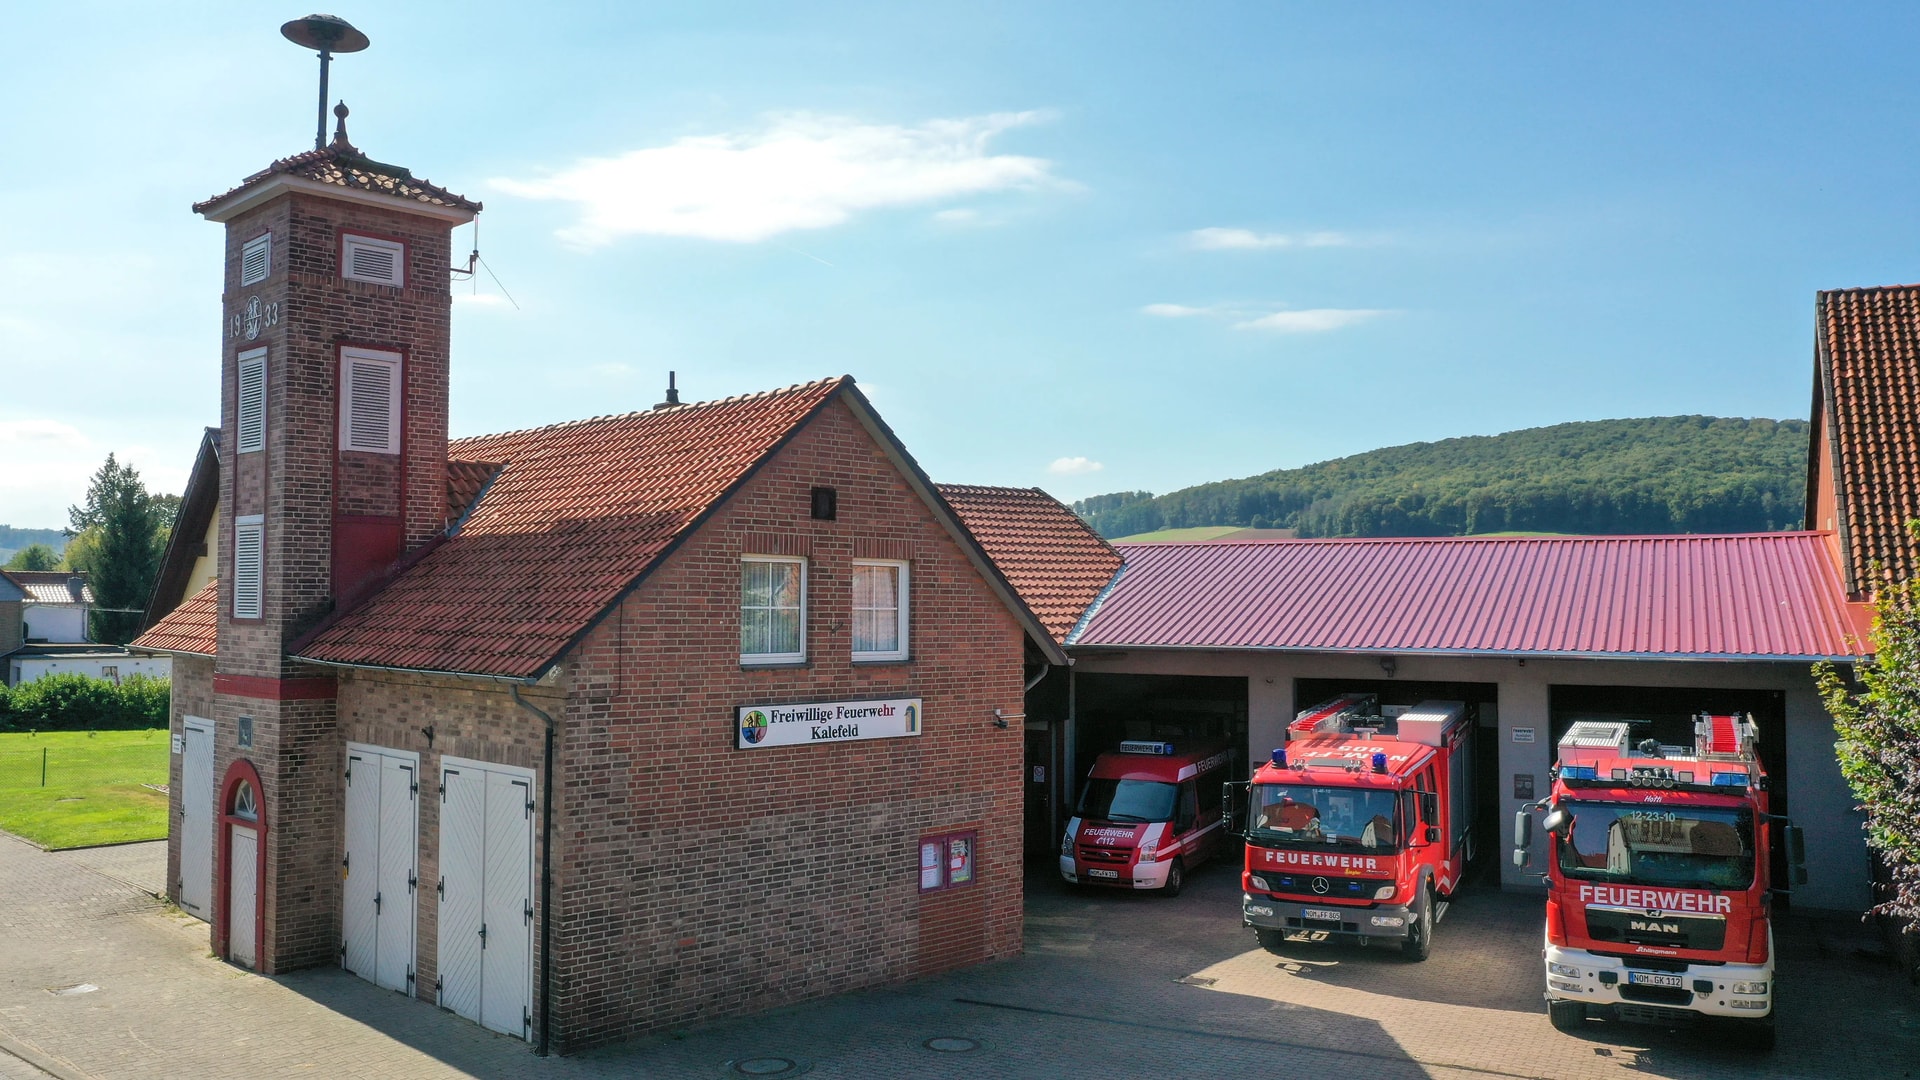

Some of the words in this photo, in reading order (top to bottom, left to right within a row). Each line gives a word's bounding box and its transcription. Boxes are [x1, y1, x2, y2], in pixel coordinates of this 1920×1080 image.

[770, 707, 833, 724] Freiwillige
[836, 703, 896, 720] Feuerwehr
[811, 723, 859, 740] Kalefeld
[1630, 810, 1675, 822] 12-23-10
[1083, 828, 1134, 839] FEUERWEHR
[1102, 837, 1115, 845] 112
[1265, 852, 1377, 870] FEUERWEHR
[1580, 885, 1732, 913] FEUERWEHR
[1631, 921, 1678, 933] MAN
[1635, 946, 1677, 955] Schlingmann
[1634, 974, 1649, 983] NOM
[1654, 976, 1664, 985] GK
[1666, 978, 1680, 986] 112
